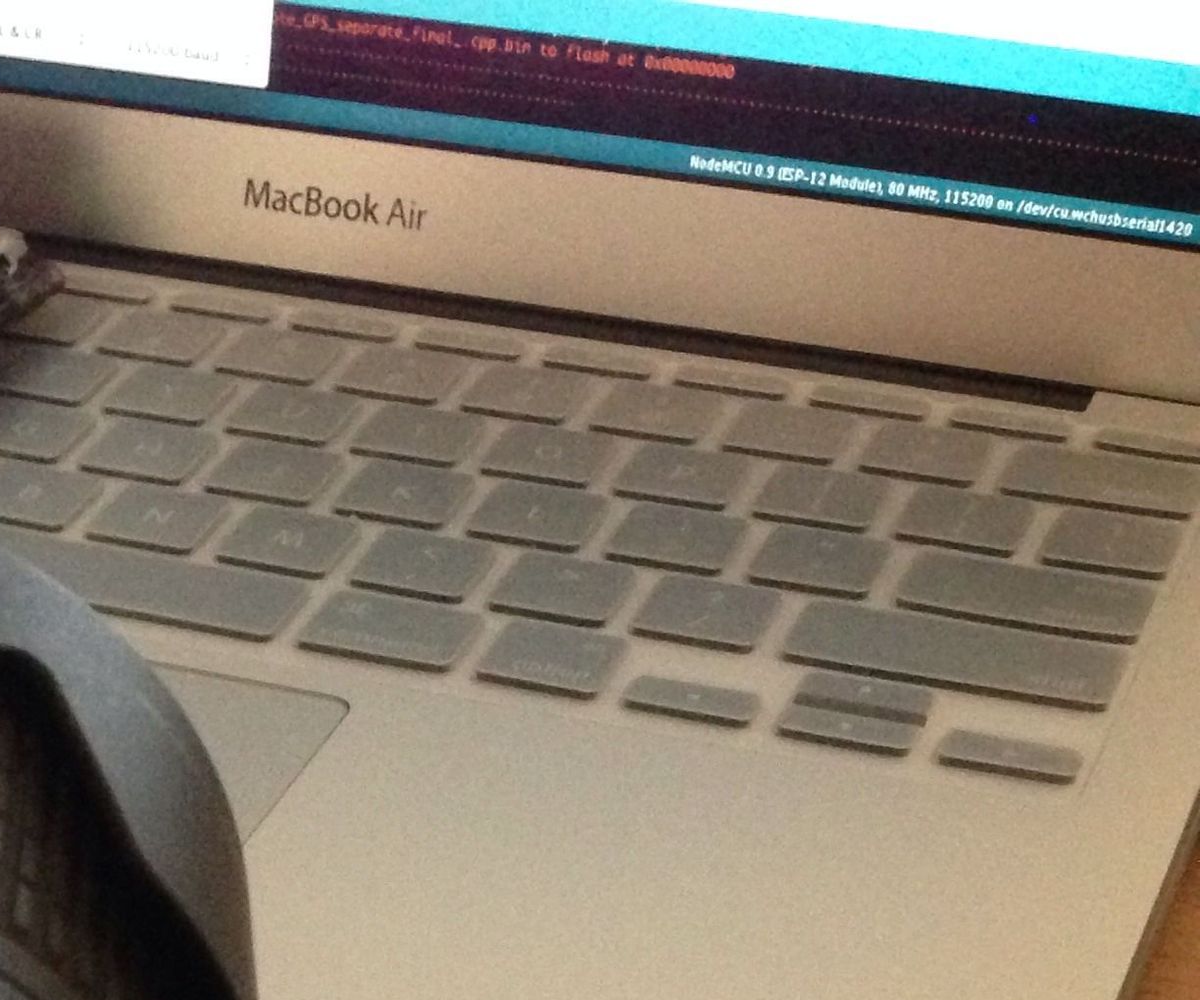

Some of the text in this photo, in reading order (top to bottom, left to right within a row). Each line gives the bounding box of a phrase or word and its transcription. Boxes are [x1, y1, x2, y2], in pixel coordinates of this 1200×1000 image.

[540, 43, 558, 58] to
[566, 43, 611, 65] flash
[617, 54, 635, 68] at
[243, 178, 428, 231] MacBook Air
[690, 155, 751, 175] NodeMCU
[755, 163, 775, 180] 0.9
[778, 166, 826, 187] (ESP-12
[888, 180, 905, 197] 80
[908, 184, 941, 205] MHz,
[945, 188, 994, 210] 115200
[997, 198, 1014, 212] on
